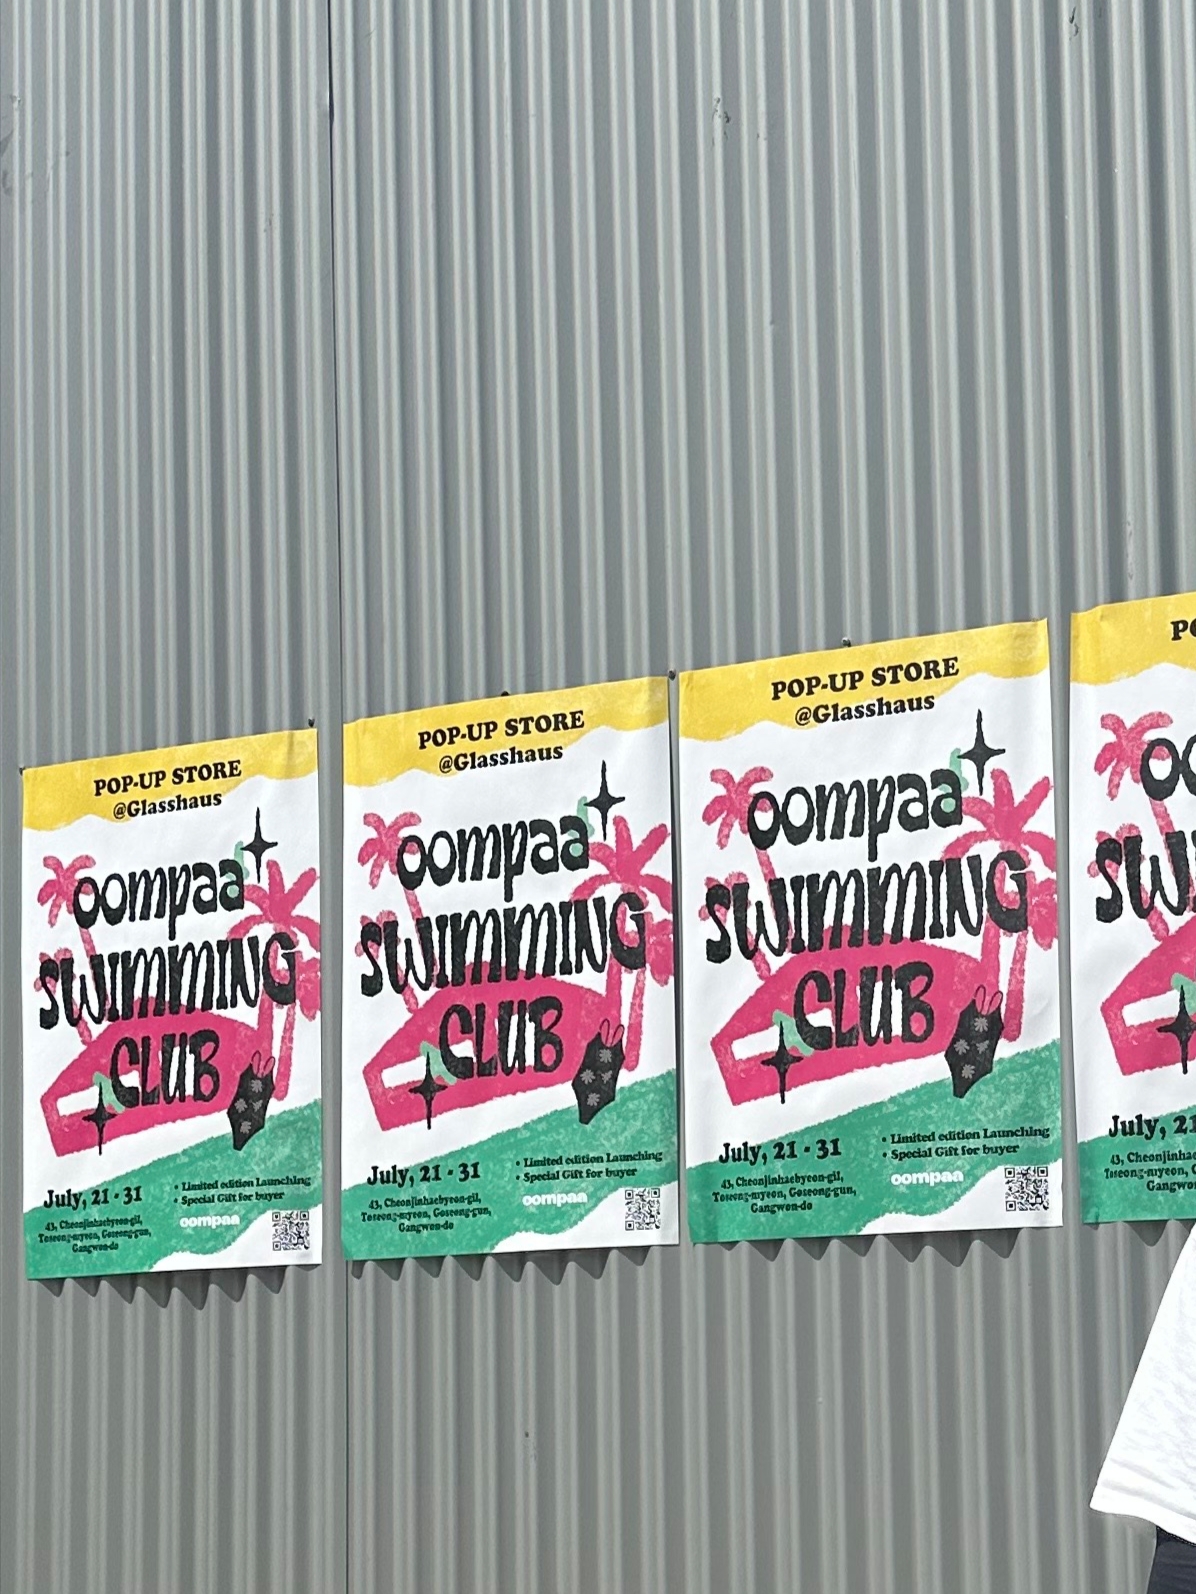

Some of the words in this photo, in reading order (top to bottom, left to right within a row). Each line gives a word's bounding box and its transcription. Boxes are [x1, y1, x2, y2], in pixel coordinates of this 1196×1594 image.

[771, 670, 864, 701] POP-UP
[871, 656, 960, 687] STORE
[795, 695, 935, 726] @Glasshaus
[418, 720, 498, 750] POP-UP
[504, 710, 585, 737] STORE
[439, 745, 563, 774] @Glasshaus
[93, 770, 167, 797] POP-UP
[171, 759, 242, 785] STORE
[113, 793, 222, 820] @Glasshaus
[746, 768, 964, 863] oompaa
[395, 815, 590, 903] oompaa
[72, 858, 245, 942] oompaa
[705, 850, 1029, 964] SWIMMING
[360, 891, 647, 998] SWIMMING
[39, 931, 297, 1030] SWIMMING
[792, 962, 934, 1050] CLUB
[438, 996, 564, 1081] CLUB
[109, 1028, 220, 1109] CLUB
[890, 1131, 936, 1145] Limited
[937, 1130, 981, 1142] edition
[982, 1126, 1050, 1139] Launching
[1108, 1113, 1167, 1140] July,
[523, 1155, 563, 1167] Limited
[565, 1153, 604, 1165] edition
[605, 1150, 663, 1162] Launching
[718, 1141, 768, 1167] July,
[772, 1140, 798, 1161] 21
[815, 1137, 842, 1160] 31
[891, 1147, 933, 1162] Special
[934, 1146, 960, 1157] Gift
[961, 1145, 981, 1156] for
[982, 1144, 1020, 1156] buyer
[181, 1180, 218, 1191] Limited
[220, 1178, 254, 1189] edition
[255, 1175, 311, 1187] Launching
[367, 1164, 414, 1188] July,
[420, 1164, 442, 1182] 21
[458, 1161, 480, 1182] 31
[523, 1171, 560, 1183] Special
[562, 1169, 583, 1179] Gift
[585, 1168, 601, 1178] for
[605, 1167, 637, 1179] buyer
[890, 1170, 964, 1186] oompaa
[44, 1188, 87, 1211] July,
[91, 1188, 109, 1206] 21
[123, 1185, 142, 1205] 31
[181, 1195, 215, 1206] Special
[217, 1193, 237, 1202] Gift
[238, 1192, 253, 1201] for
[255, 1191, 285, 1202] buyer
[522, 1192, 588, 1207] oompaa
[180, 1214, 240, 1229] oompaa
